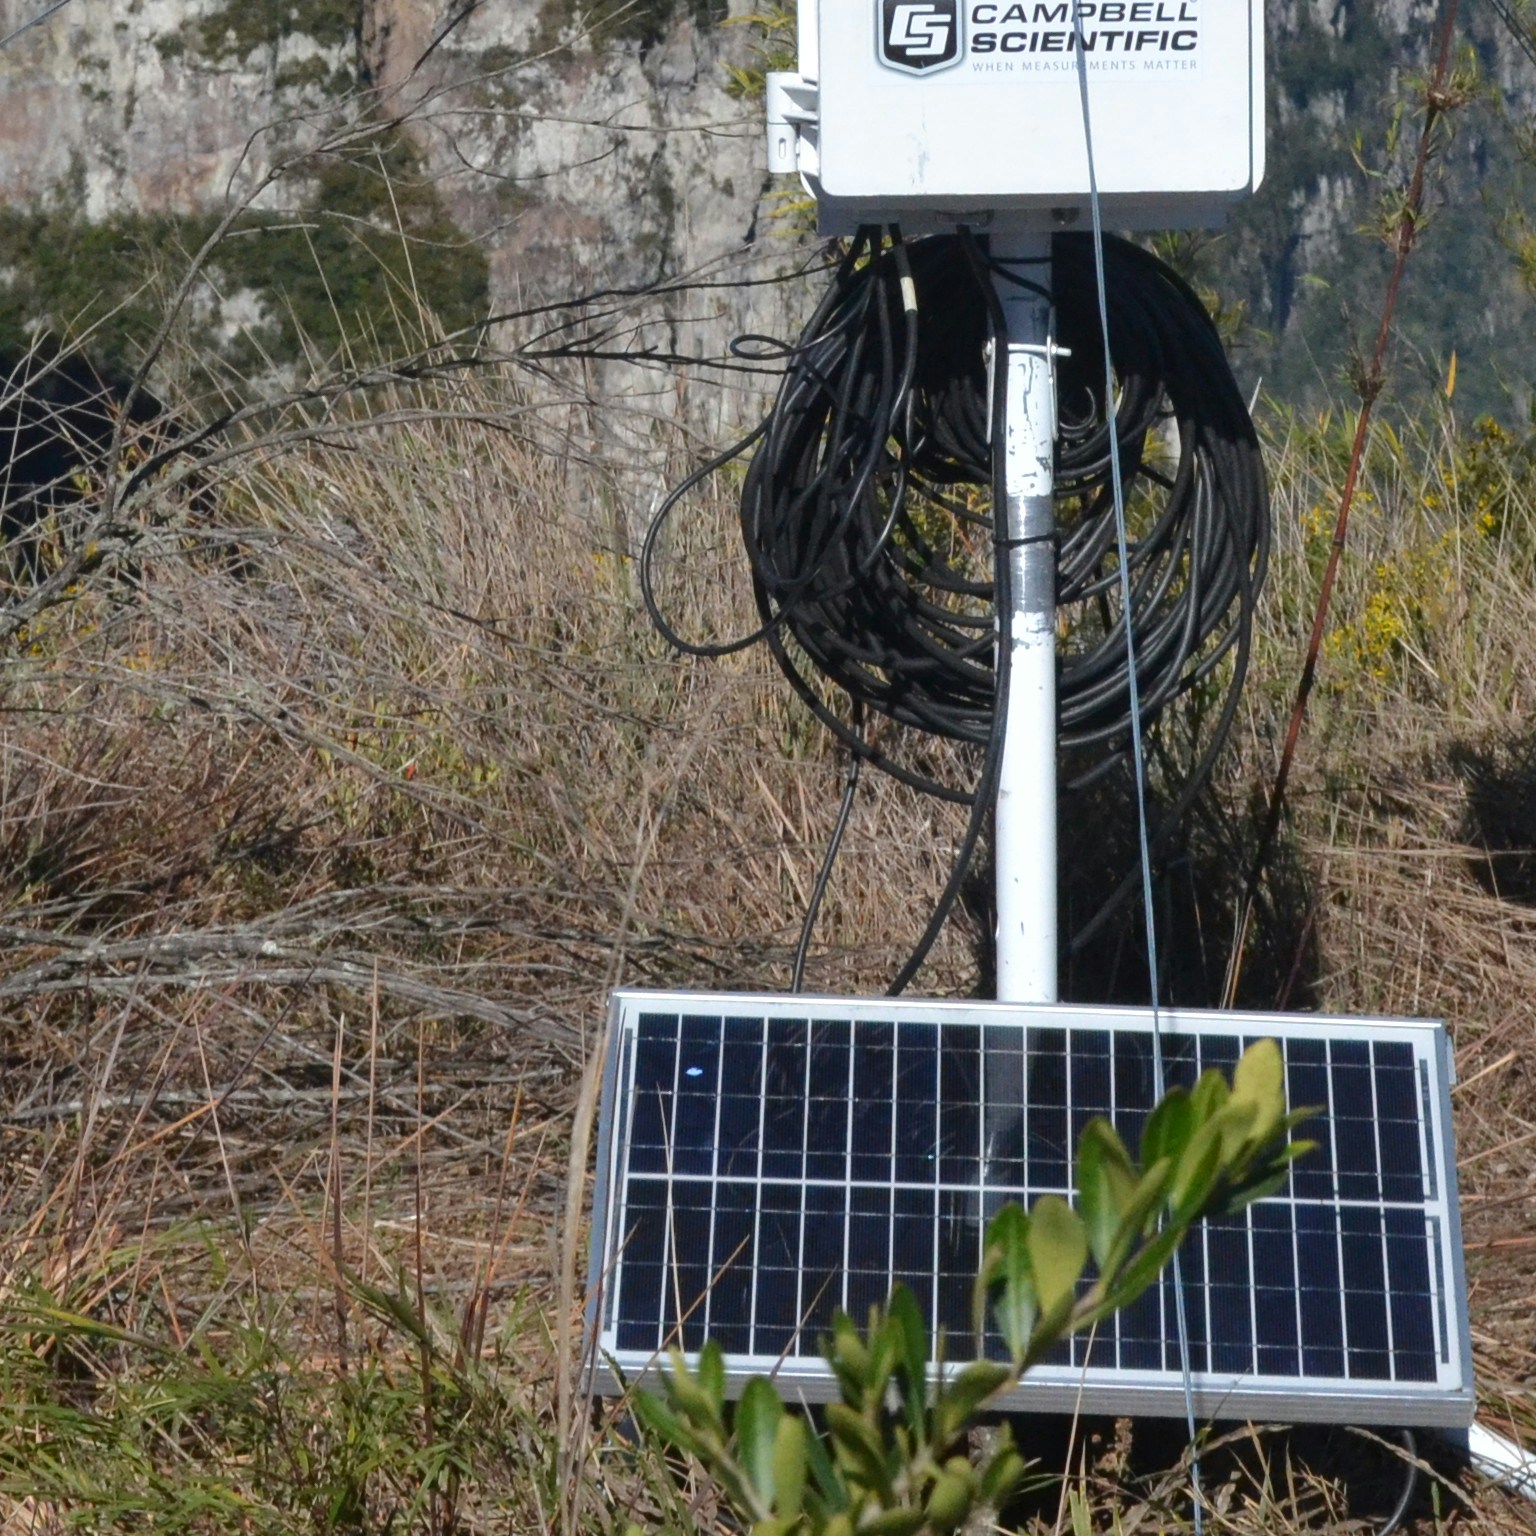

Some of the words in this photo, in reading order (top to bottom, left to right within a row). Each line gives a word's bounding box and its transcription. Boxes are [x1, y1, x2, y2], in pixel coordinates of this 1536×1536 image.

[970, 1, 1198, 25] CAMPBELL
[970, 29, 1198, 54] SCIENTIFIC
[972, 61, 1014, 72] WHEN
[1021, 60, 1137, 71] MEASURMENTS
[1143, 59, 1198, 70] MATTER
